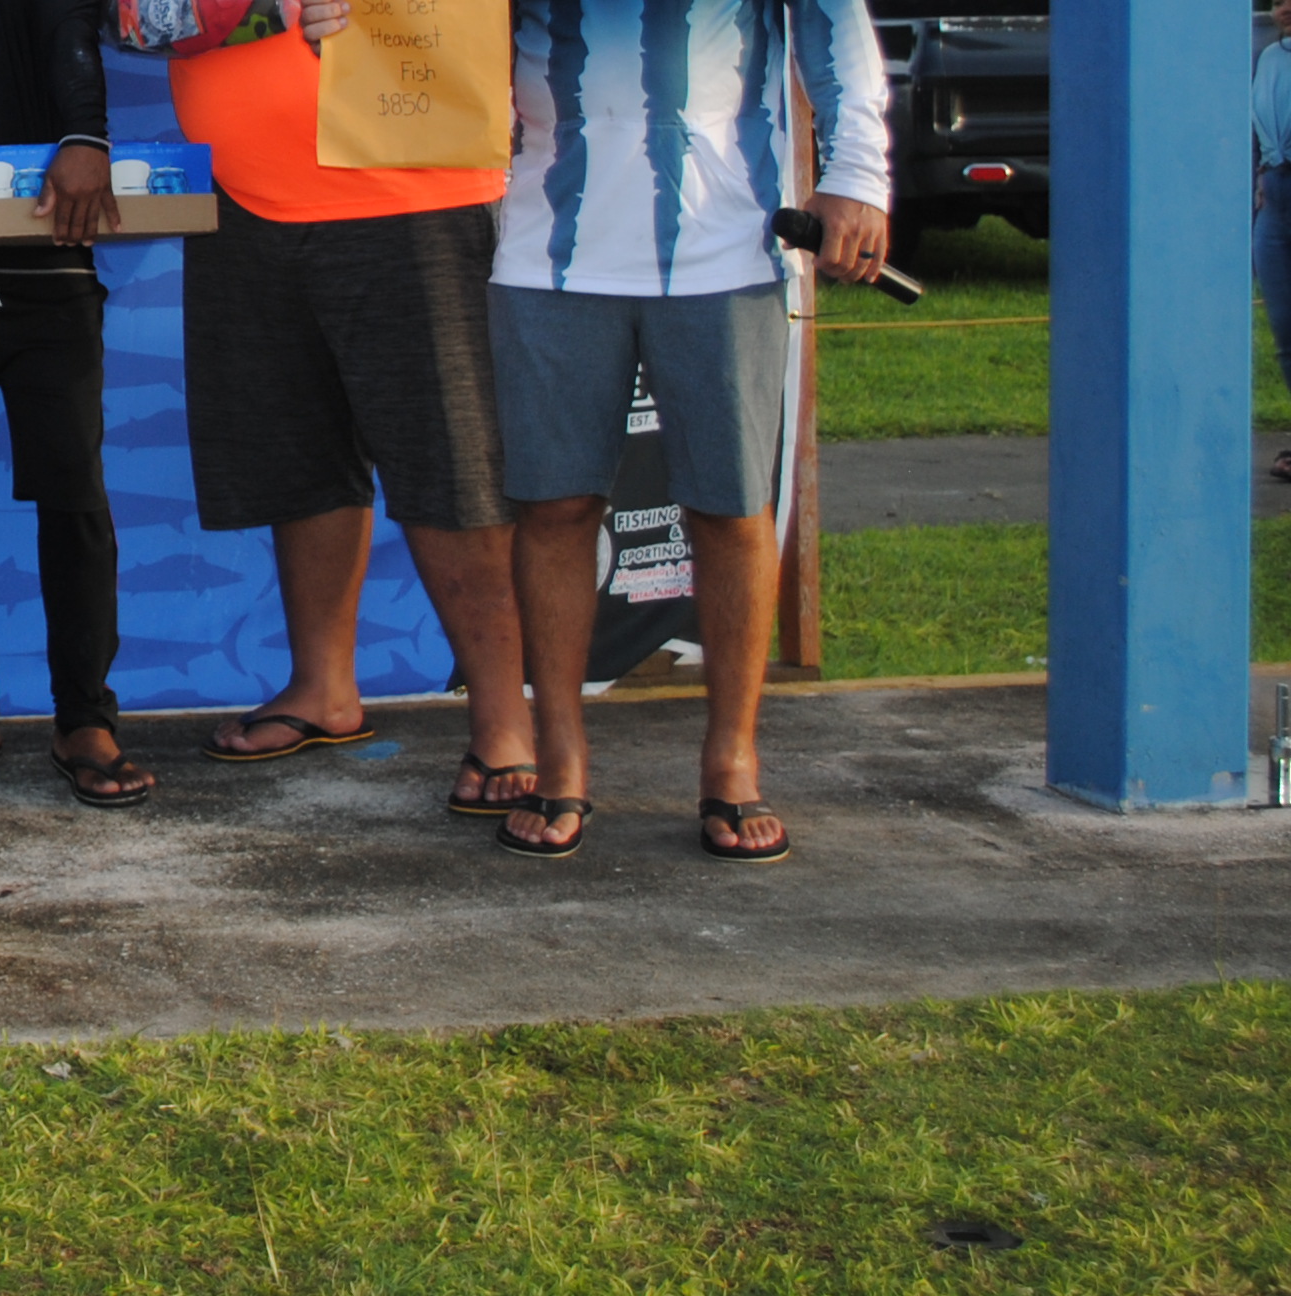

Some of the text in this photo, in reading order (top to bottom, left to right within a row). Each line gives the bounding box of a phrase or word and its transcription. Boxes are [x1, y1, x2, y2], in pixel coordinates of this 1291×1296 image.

[370, 25, 443, 49] Heaviest
[400, 61, 436, 82] Fish
[377, 92, 430, 116] $850
[616, 506, 679, 530] FISHING
[671, 525, 682, 540] &
[620, 543, 685, 565] SPORTING
